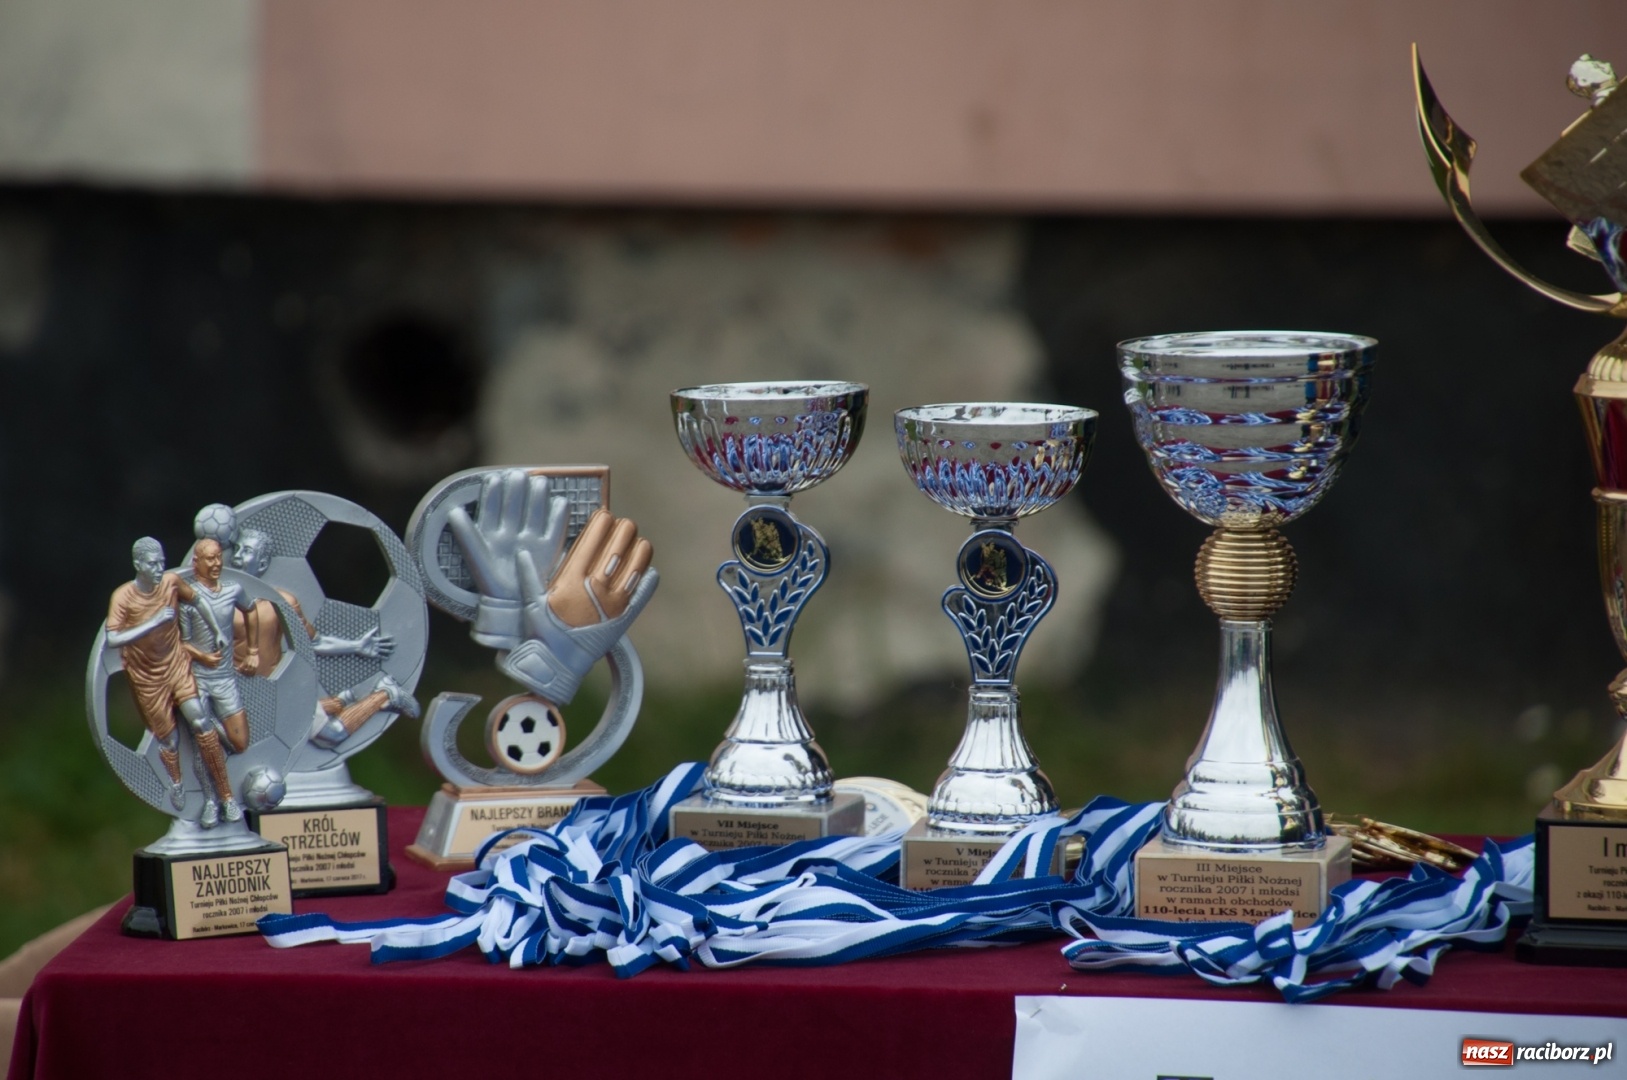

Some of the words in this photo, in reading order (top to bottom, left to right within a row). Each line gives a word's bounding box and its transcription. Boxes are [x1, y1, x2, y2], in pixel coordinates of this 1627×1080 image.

[470, 806, 534, 820] NAJLEPSZY
[537, 805, 573, 819] BRAM
[303, 814, 337, 833] KRÓL
[717, 820, 734, 828] VII
[737, 821, 779, 831] Miejsce
[281, 829, 361, 850] STRZELCÓW
[702, 829, 743, 839] Turnieju
[956, 848, 964, 856] V
[968, 848, 998, 858] Miejs
[923, 858, 932, 866] w
[935, 857, 978, 868] Turnieju
[192, 858, 271, 881] NAJLEPSZY
[925, 867, 969, 876] rocznika
[1196, 863, 1210, 872] III
[1215, 863, 1263, 874] Miejsce
[1157, 874, 1168, 882] w
[1170, 873, 1224, 884] Turnieju
[1228, 875, 1254, 884] Piłki
[1259, 876, 1302, 887] Nożnej
[195, 875, 271, 898] ZAWODNIK
[1159, 885, 1212, 894] rocznika
[1216, 886, 1247, 895] 2007
[1251, 886, 1255, 895] i
[1259, 886, 1300, 896] młodsi
[1166, 896, 1175, 904] w
[1180, 895, 1227, 905] ramach
[1230, 896, 1294, 907] obchodów
[228, 907, 244, 916] 2007
[1143, 905, 1206, 916] 110-lecia
[1210, 908, 1238, 917] LKS
